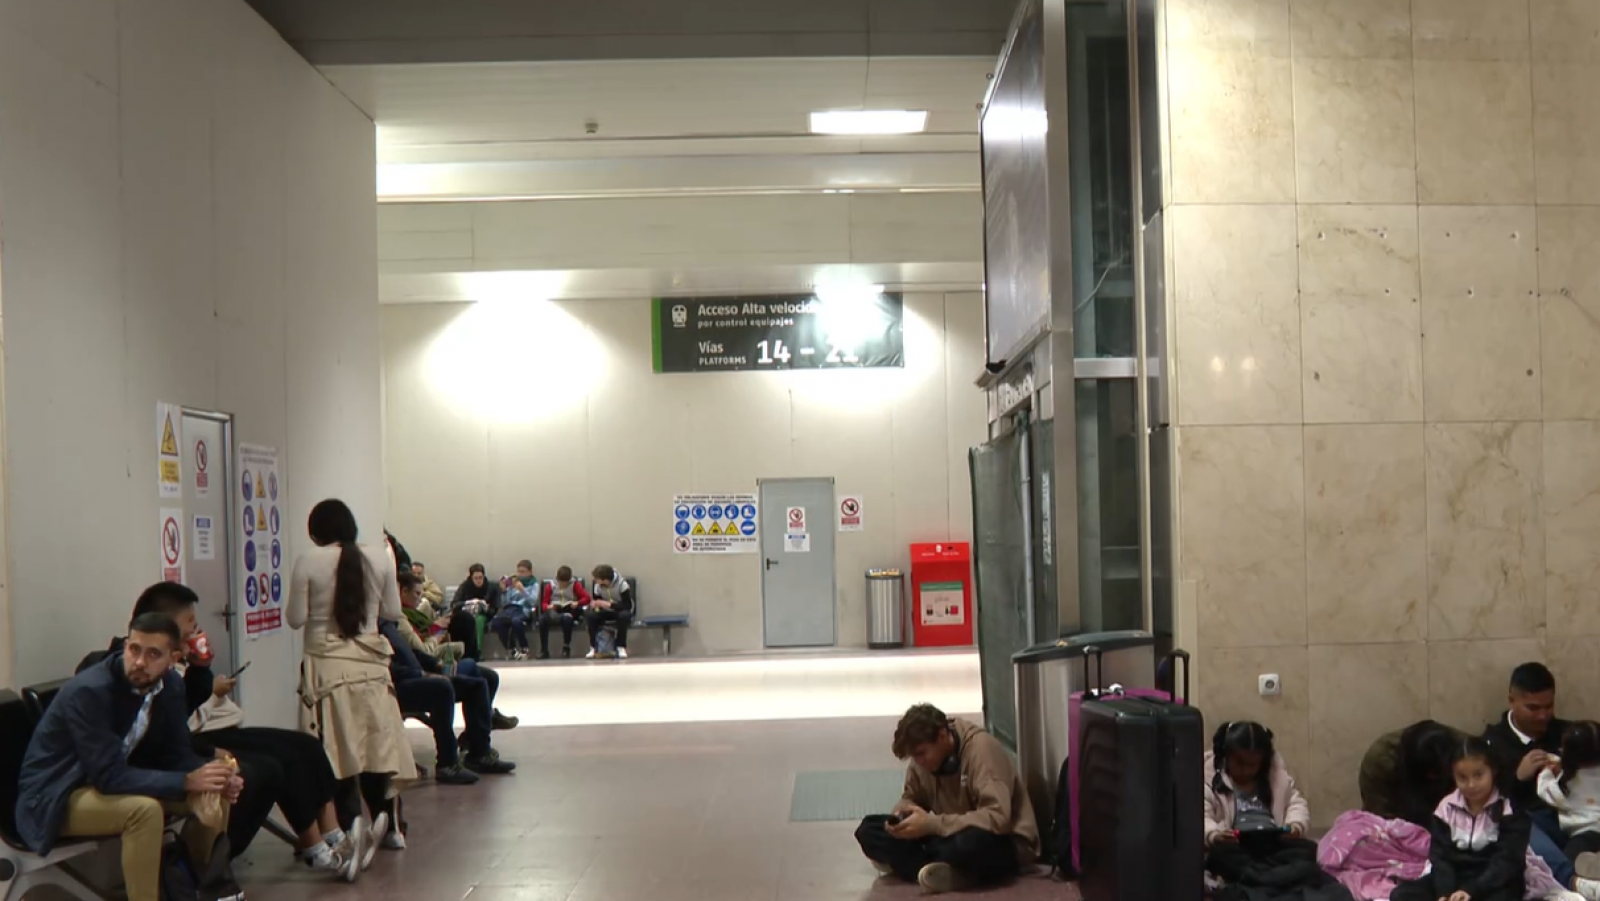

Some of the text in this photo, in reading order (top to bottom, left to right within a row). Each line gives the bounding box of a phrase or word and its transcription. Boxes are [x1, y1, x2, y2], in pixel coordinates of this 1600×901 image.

[698, 301, 819, 316] Acceso Alta velocid
[698, 317, 794, 329] por control equipajes
[698, 341, 724, 353] Vías
[757, 339, 792, 364] 14
[699, 355, 747, 366] PLATFORMS
